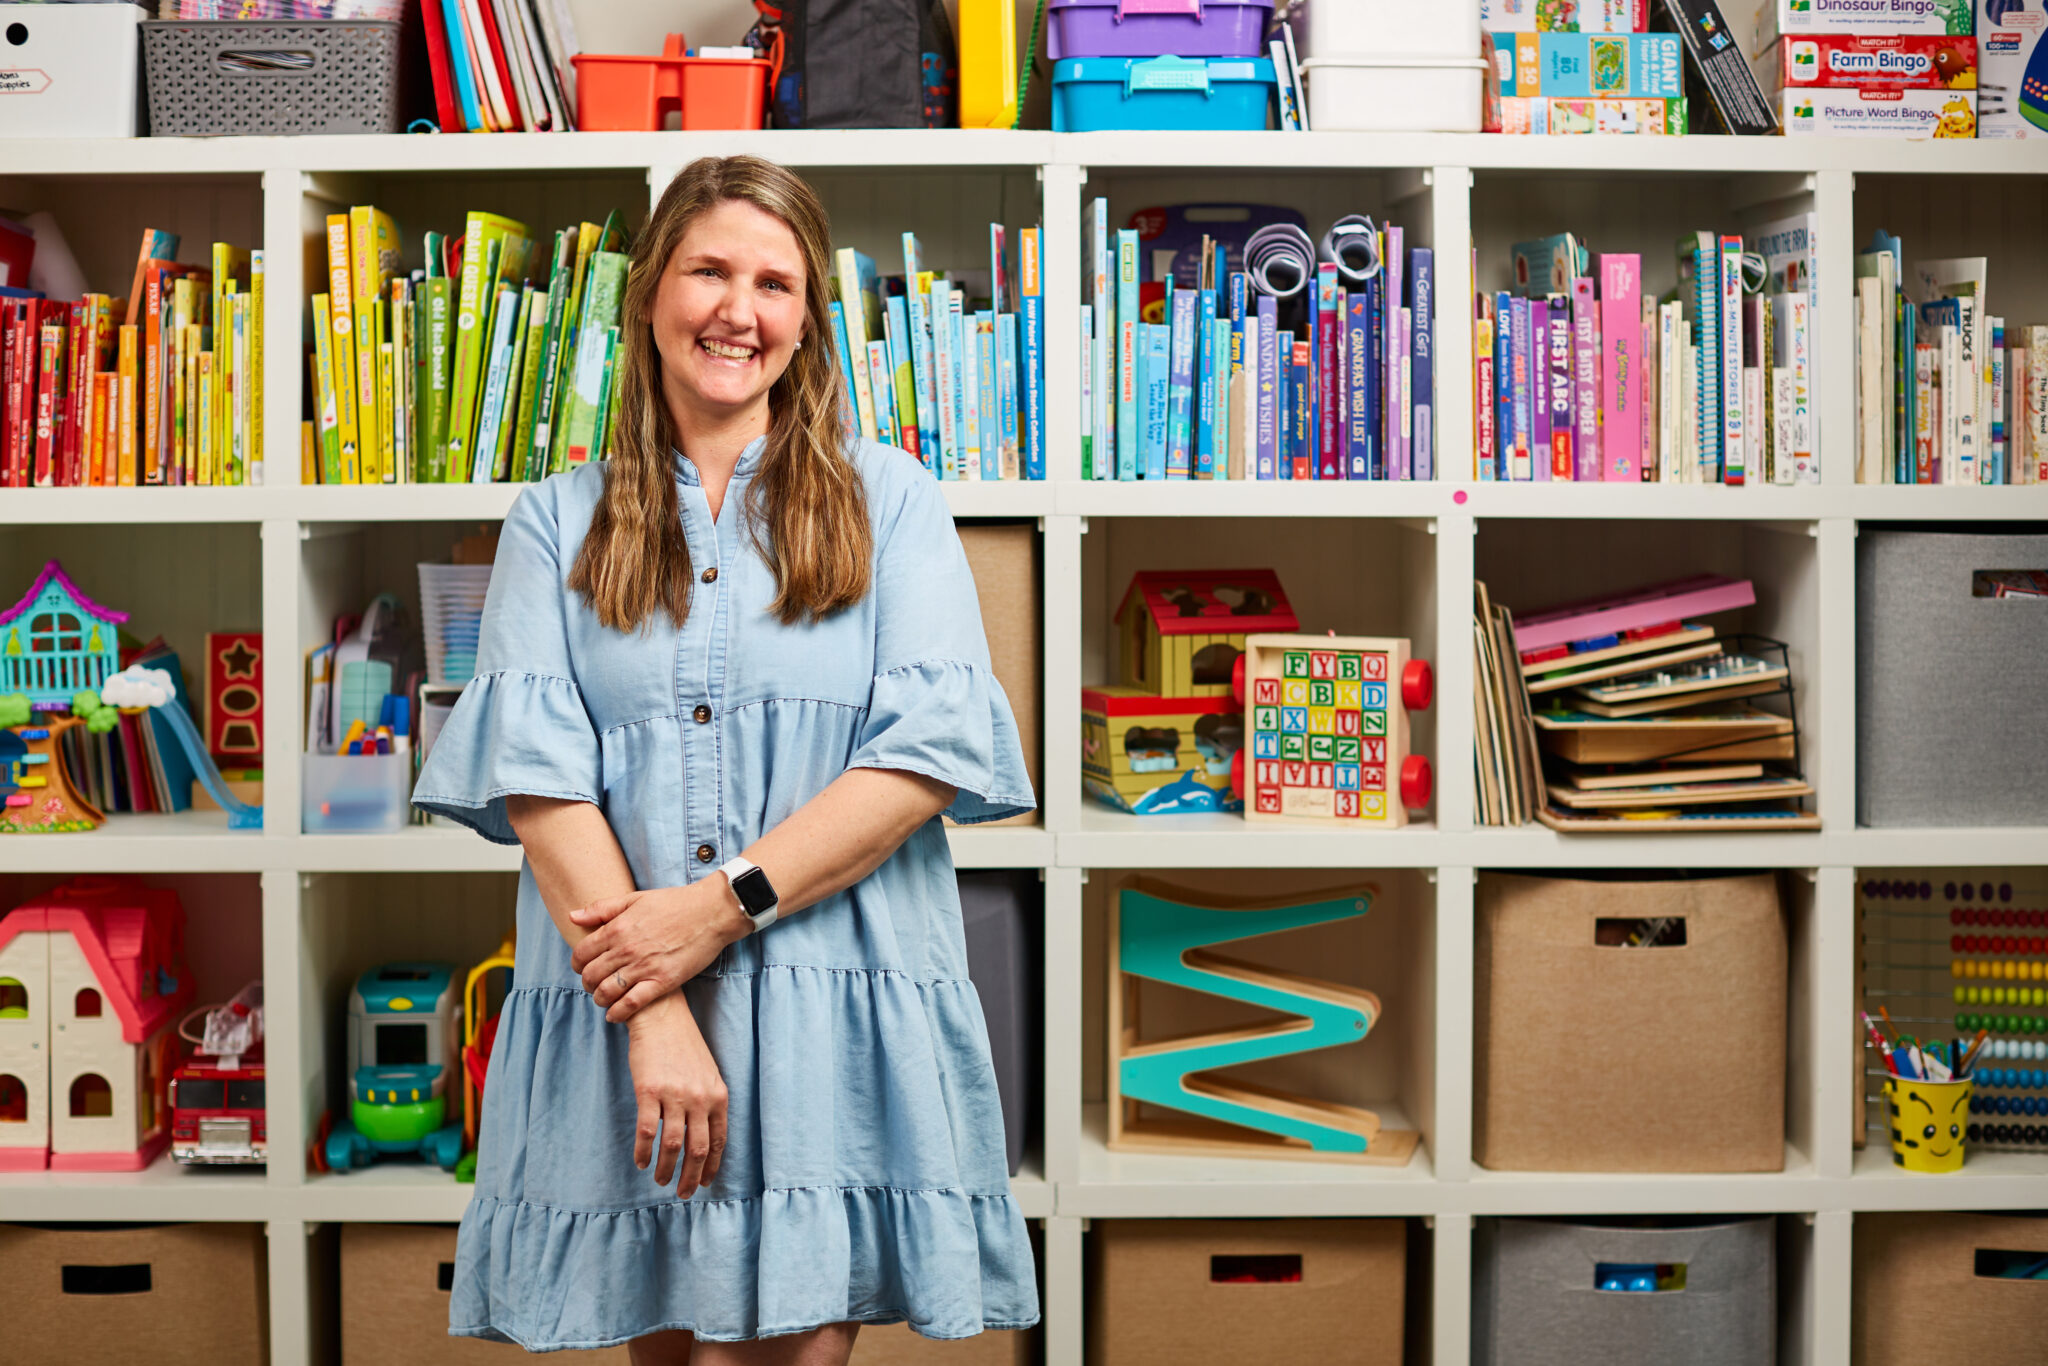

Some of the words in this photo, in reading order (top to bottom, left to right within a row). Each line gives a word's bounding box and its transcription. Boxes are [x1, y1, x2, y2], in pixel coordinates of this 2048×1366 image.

[1817, 0, 1885, 11] Dinosaur
[1890, 0, 1935, 15] Bingo
[1641, 40, 1650, 62] Floor
[1651, 38, 1661, 62] Seek
[1861, 38, 1886, 46] MATCH
[1661, 39, 1678, 93] GIANT
[1832, 53, 1874, 67] Farm
[1879, 52, 1927, 71] Bingo
[1526, 66, 1537, 85] 50
[1641, 64, 1650, 92] Puzzle
[1651, 73, 1661, 94] Find
[1862, 92, 1887, 100] MATCH
[1825, 107, 1863, 118] Picture
[1867, 107, 1898, 118] Word
[1902, 108, 1935, 121] Bingo
[329, 223, 347, 266] BRAIN
[464, 219, 481, 261] BRAIN
[1026, 237, 1035, 288] nickelodeon
[1418, 266, 1428, 279] The
[149, 282, 158, 315] PIXAR
[332, 269, 349, 313] QUEST
[462, 264, 479, 311] QUEST
[433, 297, 445, 320] Old
[1027, 299, 1036, 319] PAW
[1390, 304, 1399, 337] Summer
[1795, 303, 1805, 324] See
[1028, 320, 1036, 347] Patrol
[1499, 309, 1510, 336] LOVE
[1536, 326, 1545, 342] The
[1577, 316, 1593, 345] ITSY
[1728, 298, 1737, 356] 5-MINUTE
[1962, 306, 1972, 361] TRUCKS
[1124, 321, 1133, 362] 5-MINUTE
[1232, 332, 1243, 361] Farm
[1260, 313, 1274, 381] GRANDMA
[1552, 319, 1568, 370] FIRST
[1795, 327, 1805, 354] Touch
[433, 322, 445, 389] MacDonald
[1029, 350, 1037, 388] 5-Minute
[1352, 328, 1365, 386] GRANDPA'S
[1536, 343, 1545, 371] Wheels
[1577, 348, 1594, 386] BITSY
[1796, 358, 1806, 380] Feel
[941, 353, 951, 403] AUSTRALIAN
[1124, 365, 1133, 403] STORIES
[1157, 379, 1166, 399] Little
[1391, 364, 1399, 402] Activities
[1536, 372, 1545, 382] on
[1536, 383, 1545, 397] the
[1729, 357, 1738, 406] STORIES
[2040, 377, 2048, 392] The
[1150, 384, 1158, 406] Leads
[1296, 383, 1305, 402] good
[1352, 389, 1365, 417] WISH
[1536, 398, 1545, 414] Bus
[1552, 373, 1568, 413] ABC
[944, 405, 953, 442] ANIMALS
[1157, 401, 1166, 420] Blue
[1260, 395, 1274, 445] WISHES
[1296, 403, 1305, 421] night
[1579, 389, 1595, 435] SPIDER
[1917, 389, 1929, 432] Words
[1148, 422, 1157, 441] Way
[1157, 422, 1166, 446] Truck
[1296, 422, 1305, 440] yoga
[1352, 419, 1365, 446] LIST
[2040, 415, 2048, 434] Seed
[1031, 419, 1039, 461] Collection
[1289, 656, 1304, 674] F
[1317, 656, 1330, 676] Y
[1342, 660, 1356, 678] B
[1367, 659, 1382, 678] Q
[1259, 684, 1274, 701] M
[1288, 684, 1304, 701] C
[1314, 685, 1329, 702] B
[1340, 688, 1356, 705] K
[1367, 688, 1383, 705] D
[1262, 711, 1271, 727] 4
[1286, 711, 1302, 729] X
[1311, 710, 1330, 729] W
[1340, 715, 1356, 734] U
[1259, 736, 1275, 754] T
[1366, 743, 1381, 760] Y
[1342, 795, 1352, 813] 3
